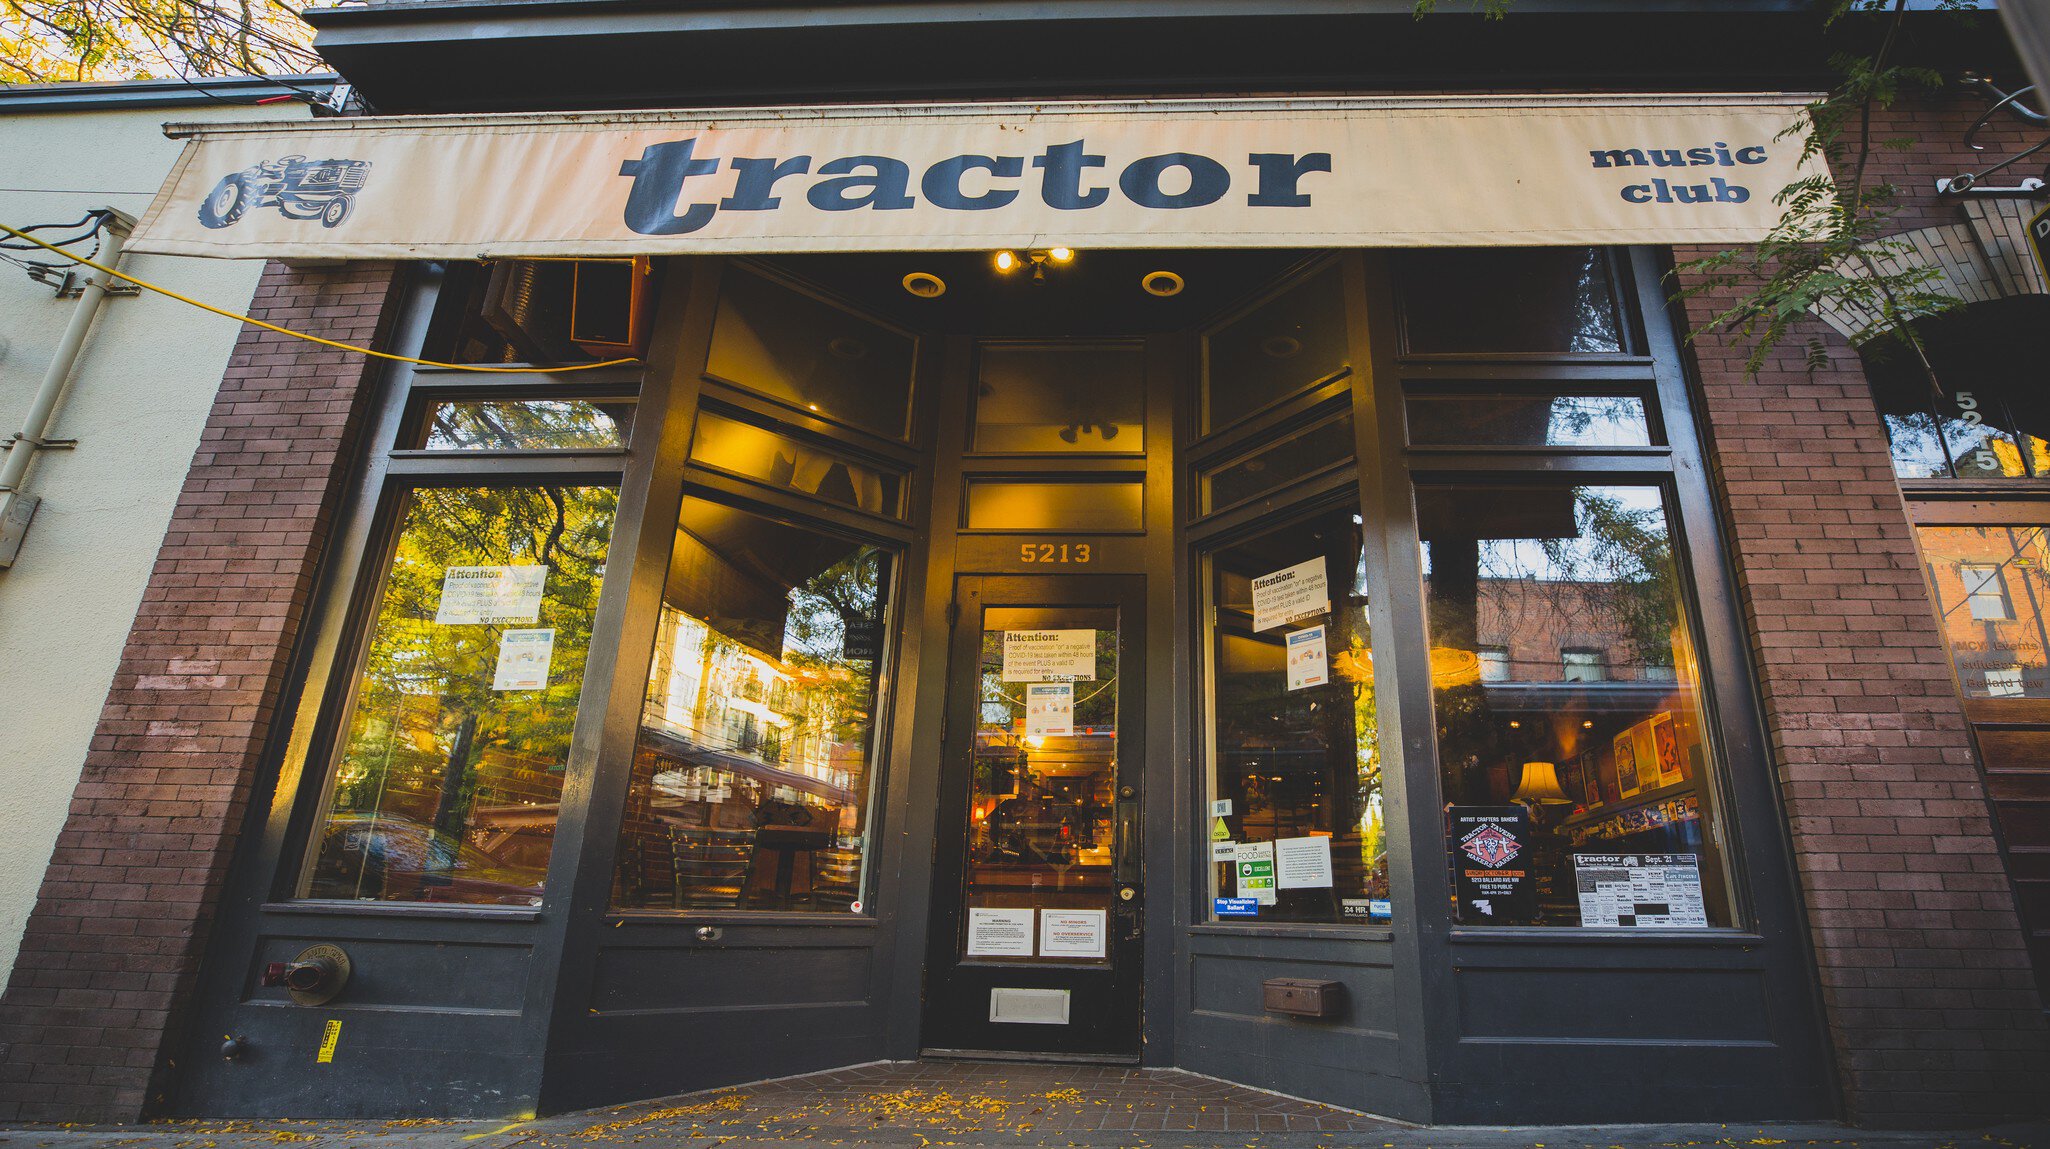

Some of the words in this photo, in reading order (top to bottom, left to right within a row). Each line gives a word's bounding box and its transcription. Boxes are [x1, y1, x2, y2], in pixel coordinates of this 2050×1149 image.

[1590, 142, 1768, 168] music
[619, 137, 1331, 235] tractor
[1620, 177, 1750, 203] club
[1021, 544, 1090, 562] 5213
[1254, 571, 1296, 591] Attention:
[1257, 591, 1266, 599] Proof
[1272, 583, 1294, 594] vaccination
[1306, 574, 1323, 584] negative
[1257, 596, 1277, 608] COVID-19
[1285, 591, 1296, 599] taken
[1296, 587, 1308, 596] within
[1314, 582, 1326, 590] hours
[1269, 605, 1280, 613] event
[1280, 600, 1292, 609] PLUS
[1296, 596, 1305, 604] valid
[1262, 614, 1279, 624] required
[1294, 607, 1326, 621] EXCEPTIONS
[1006, 633, 1059, 642] Attention:
[1956, 641, 1989, 651] MCW
[1994, 641, 2038, 651] Events
[1966, 679, 2014, 688] Ballard
[2018, 679, 2044, 688] Law
[1461, 823, 1489, 843] TRACTOR
[1491, 823, 1517, 841] TAVERN
[1238, 852, 1259, 860] FOOD
[1467, 853, 1493, 869] MAKERS
[1495, 851, 1519, 869] MARKET
[1577, 856, 1621, 864] tractor
[1645, 856, 1663, 865] Sept.
